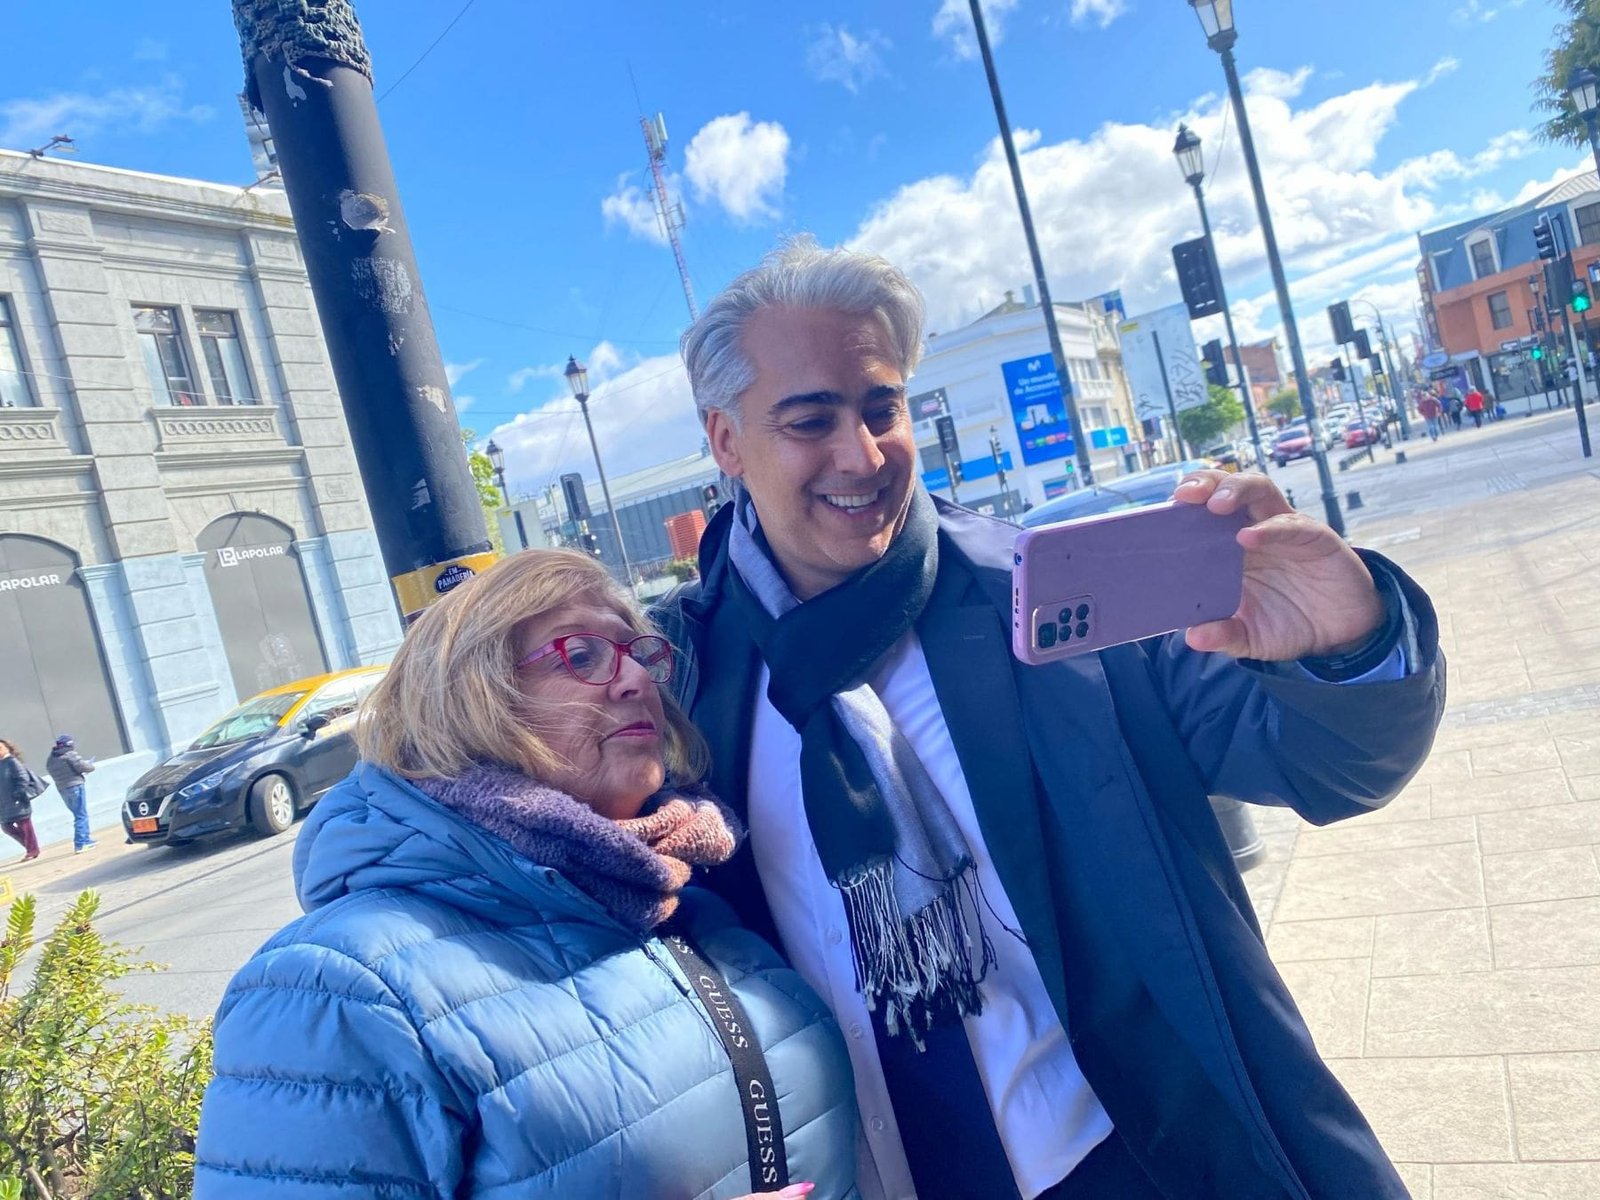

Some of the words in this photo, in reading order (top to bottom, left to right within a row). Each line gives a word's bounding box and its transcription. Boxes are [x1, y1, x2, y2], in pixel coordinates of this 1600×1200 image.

[0, 574, 60, 591] APOLAR
[699, 974, 749, 1049] GUESS
[749, 1079, 778, 1184] GUESS
